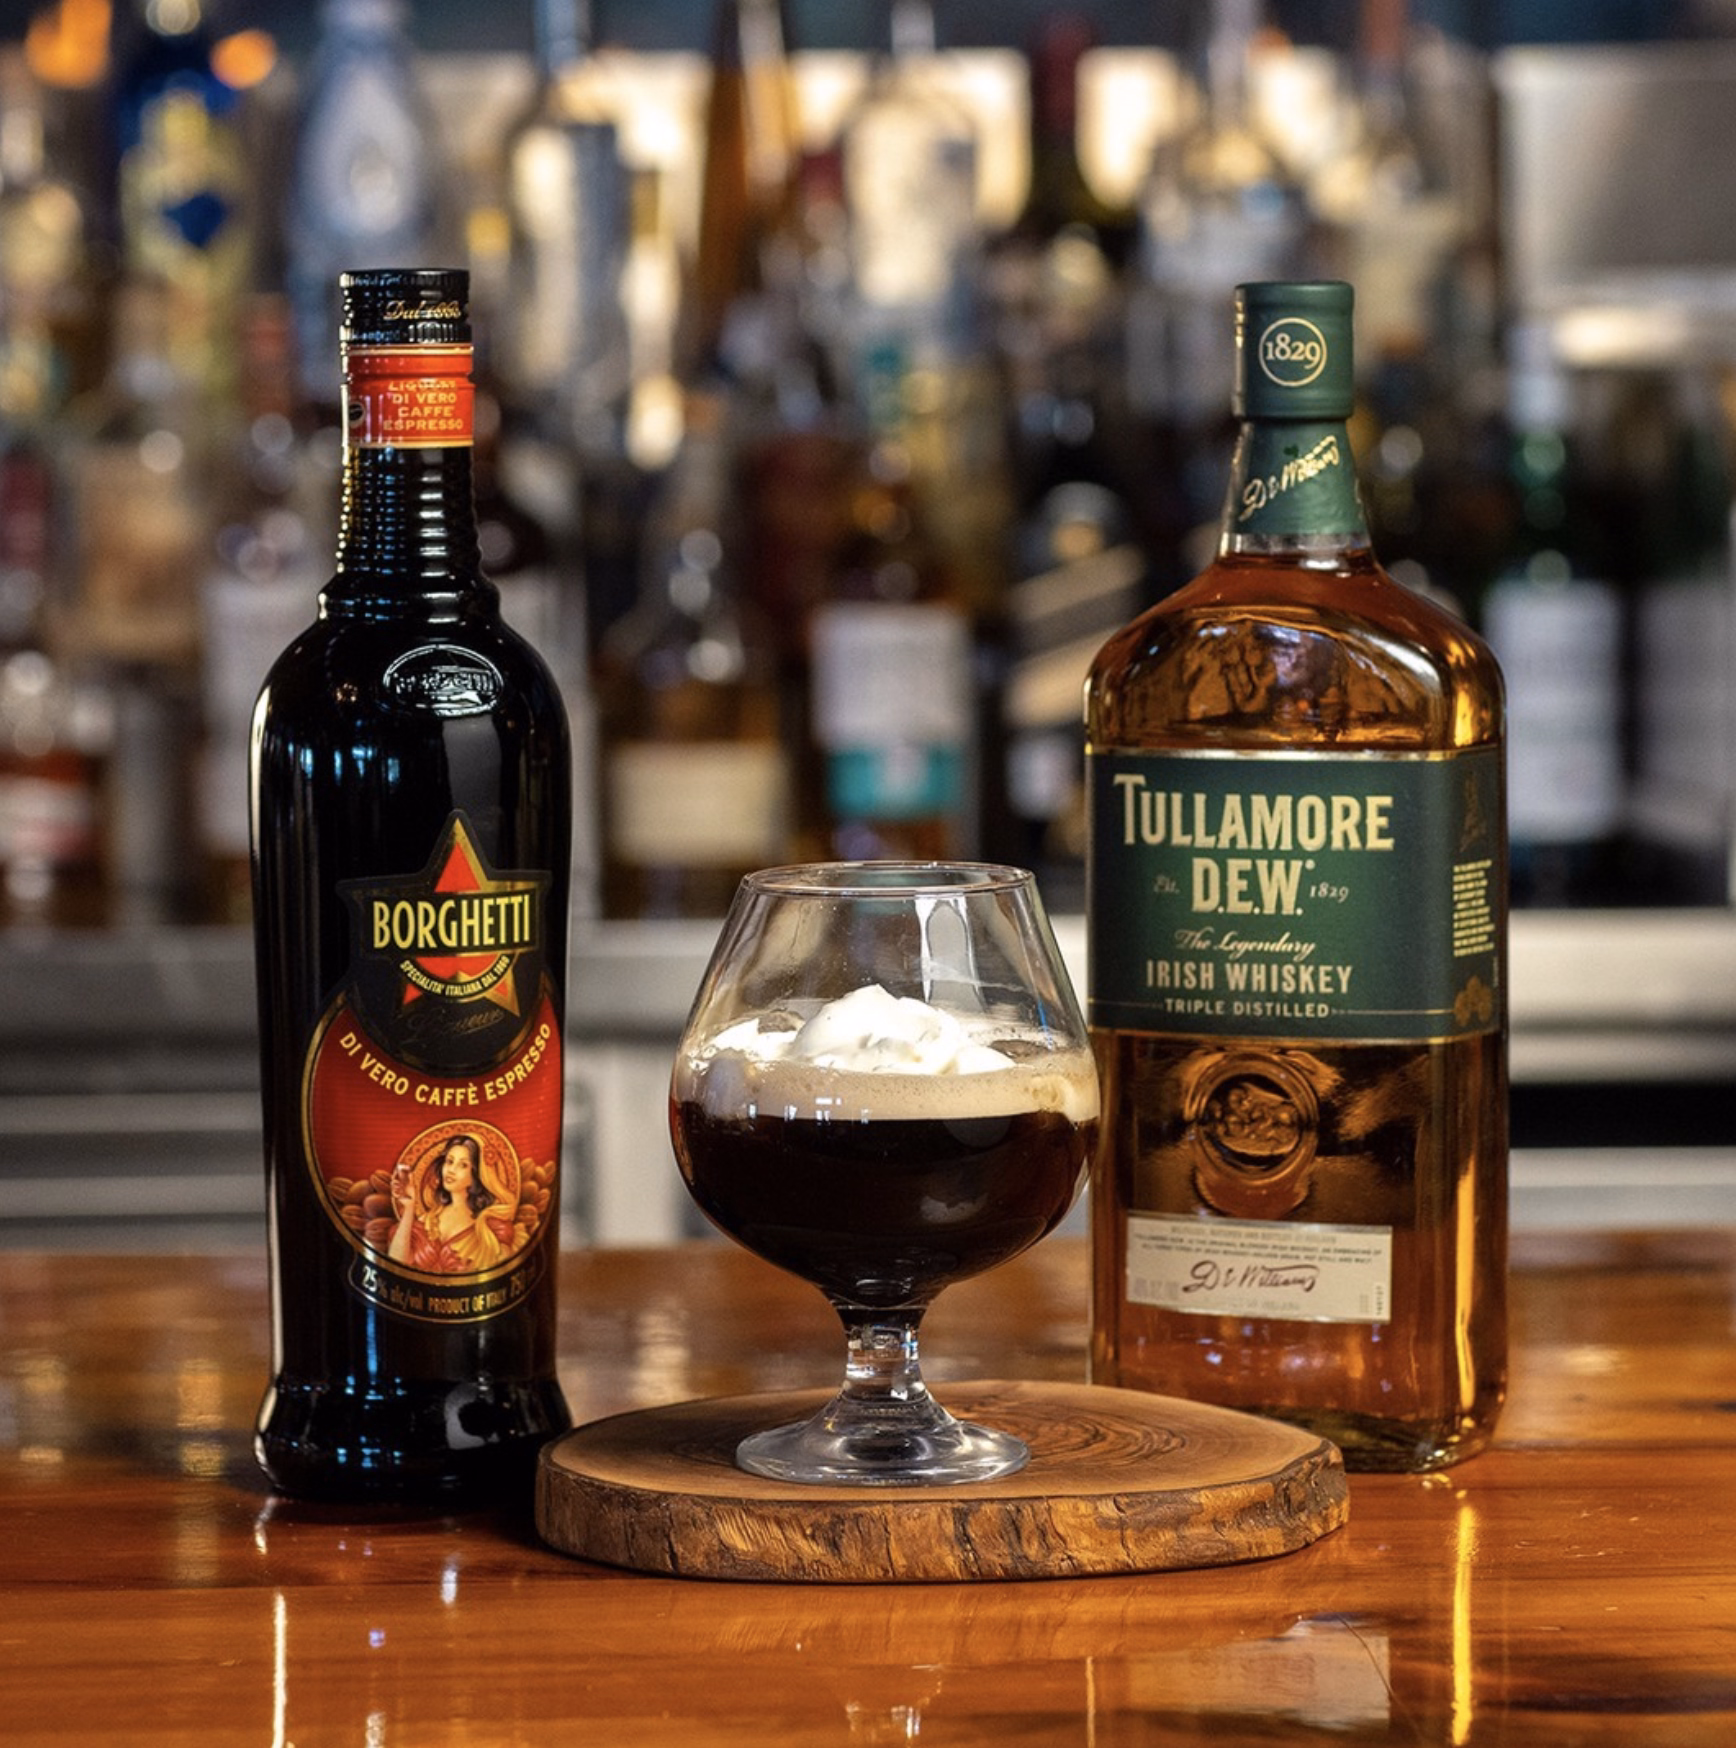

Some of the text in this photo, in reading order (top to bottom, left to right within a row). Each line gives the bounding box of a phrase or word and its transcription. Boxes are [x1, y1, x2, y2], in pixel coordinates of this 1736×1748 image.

[1265, 333, 1321, 370] 1829
[393, 392, 457, 404] DI VERO
[383, 419, 463, 431] ESPRESSO
[1113, 774, 1395, 851] TULLAMORE
[1309, 881, 1349, 903] 1829
[373, 894, 530, 949] BORGHETTI
[1174, 926, 1316, 962] The Legendary
[1147, 960, 1353, 994] IRISH WHISKEY
[1165, 998, 1329, 1018] TRIPLE DISTILLED
[339, 1023, 550, 1106] DI VERO CAFFÈ ESPRESSO
[472, 1294, 485, 1312] OF
